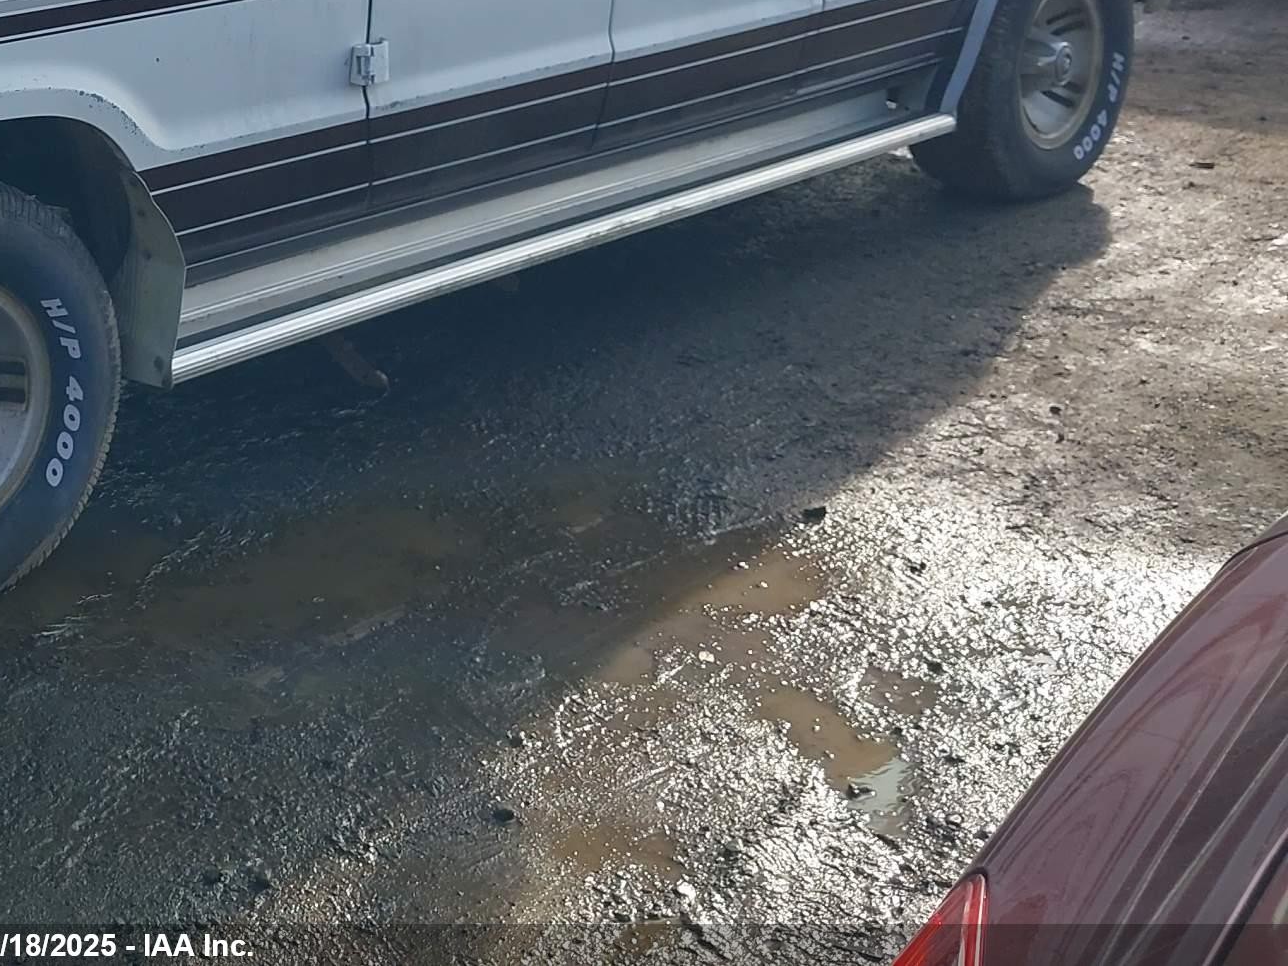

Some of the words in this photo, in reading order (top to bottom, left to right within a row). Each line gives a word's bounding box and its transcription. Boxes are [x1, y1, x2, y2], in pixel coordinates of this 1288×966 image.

[1107, 52, 1125, 103] H/P
[1073, 109, 1107, 160] 4000
[40, 298, 81, 359] H/P
[45, 375, 83, 488] 4000
